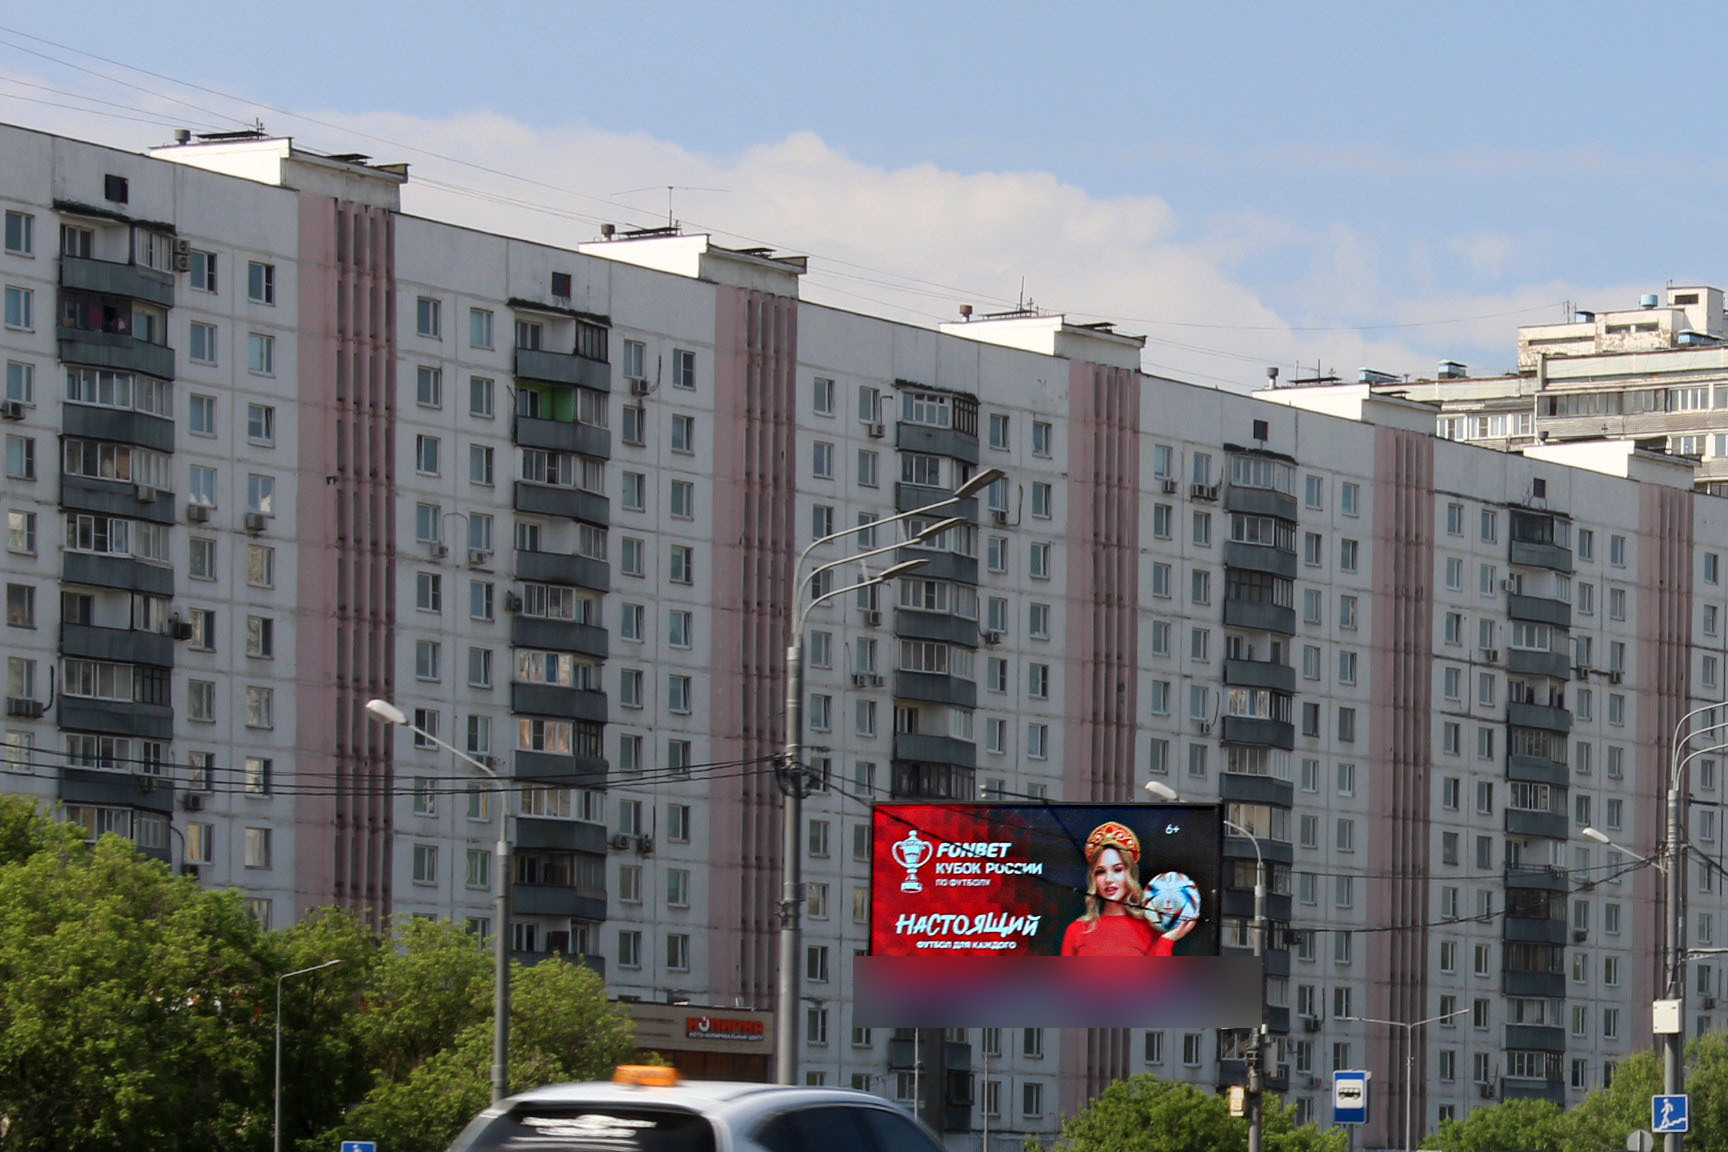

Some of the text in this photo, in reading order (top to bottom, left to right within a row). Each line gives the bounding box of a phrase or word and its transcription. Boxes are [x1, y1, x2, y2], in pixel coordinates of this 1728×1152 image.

[1165, 823, 1181, 835] 6+
[937, 843, 1012, 858] FONBET
[935, 862, 1043, 875] КУБОК РОССИИ
[935, 878, 991, 887] ПО ФУТБОЛУ
[916, 941, 1017, 949] ФУТБОЛ ДЛЯ КАЖДОГО
